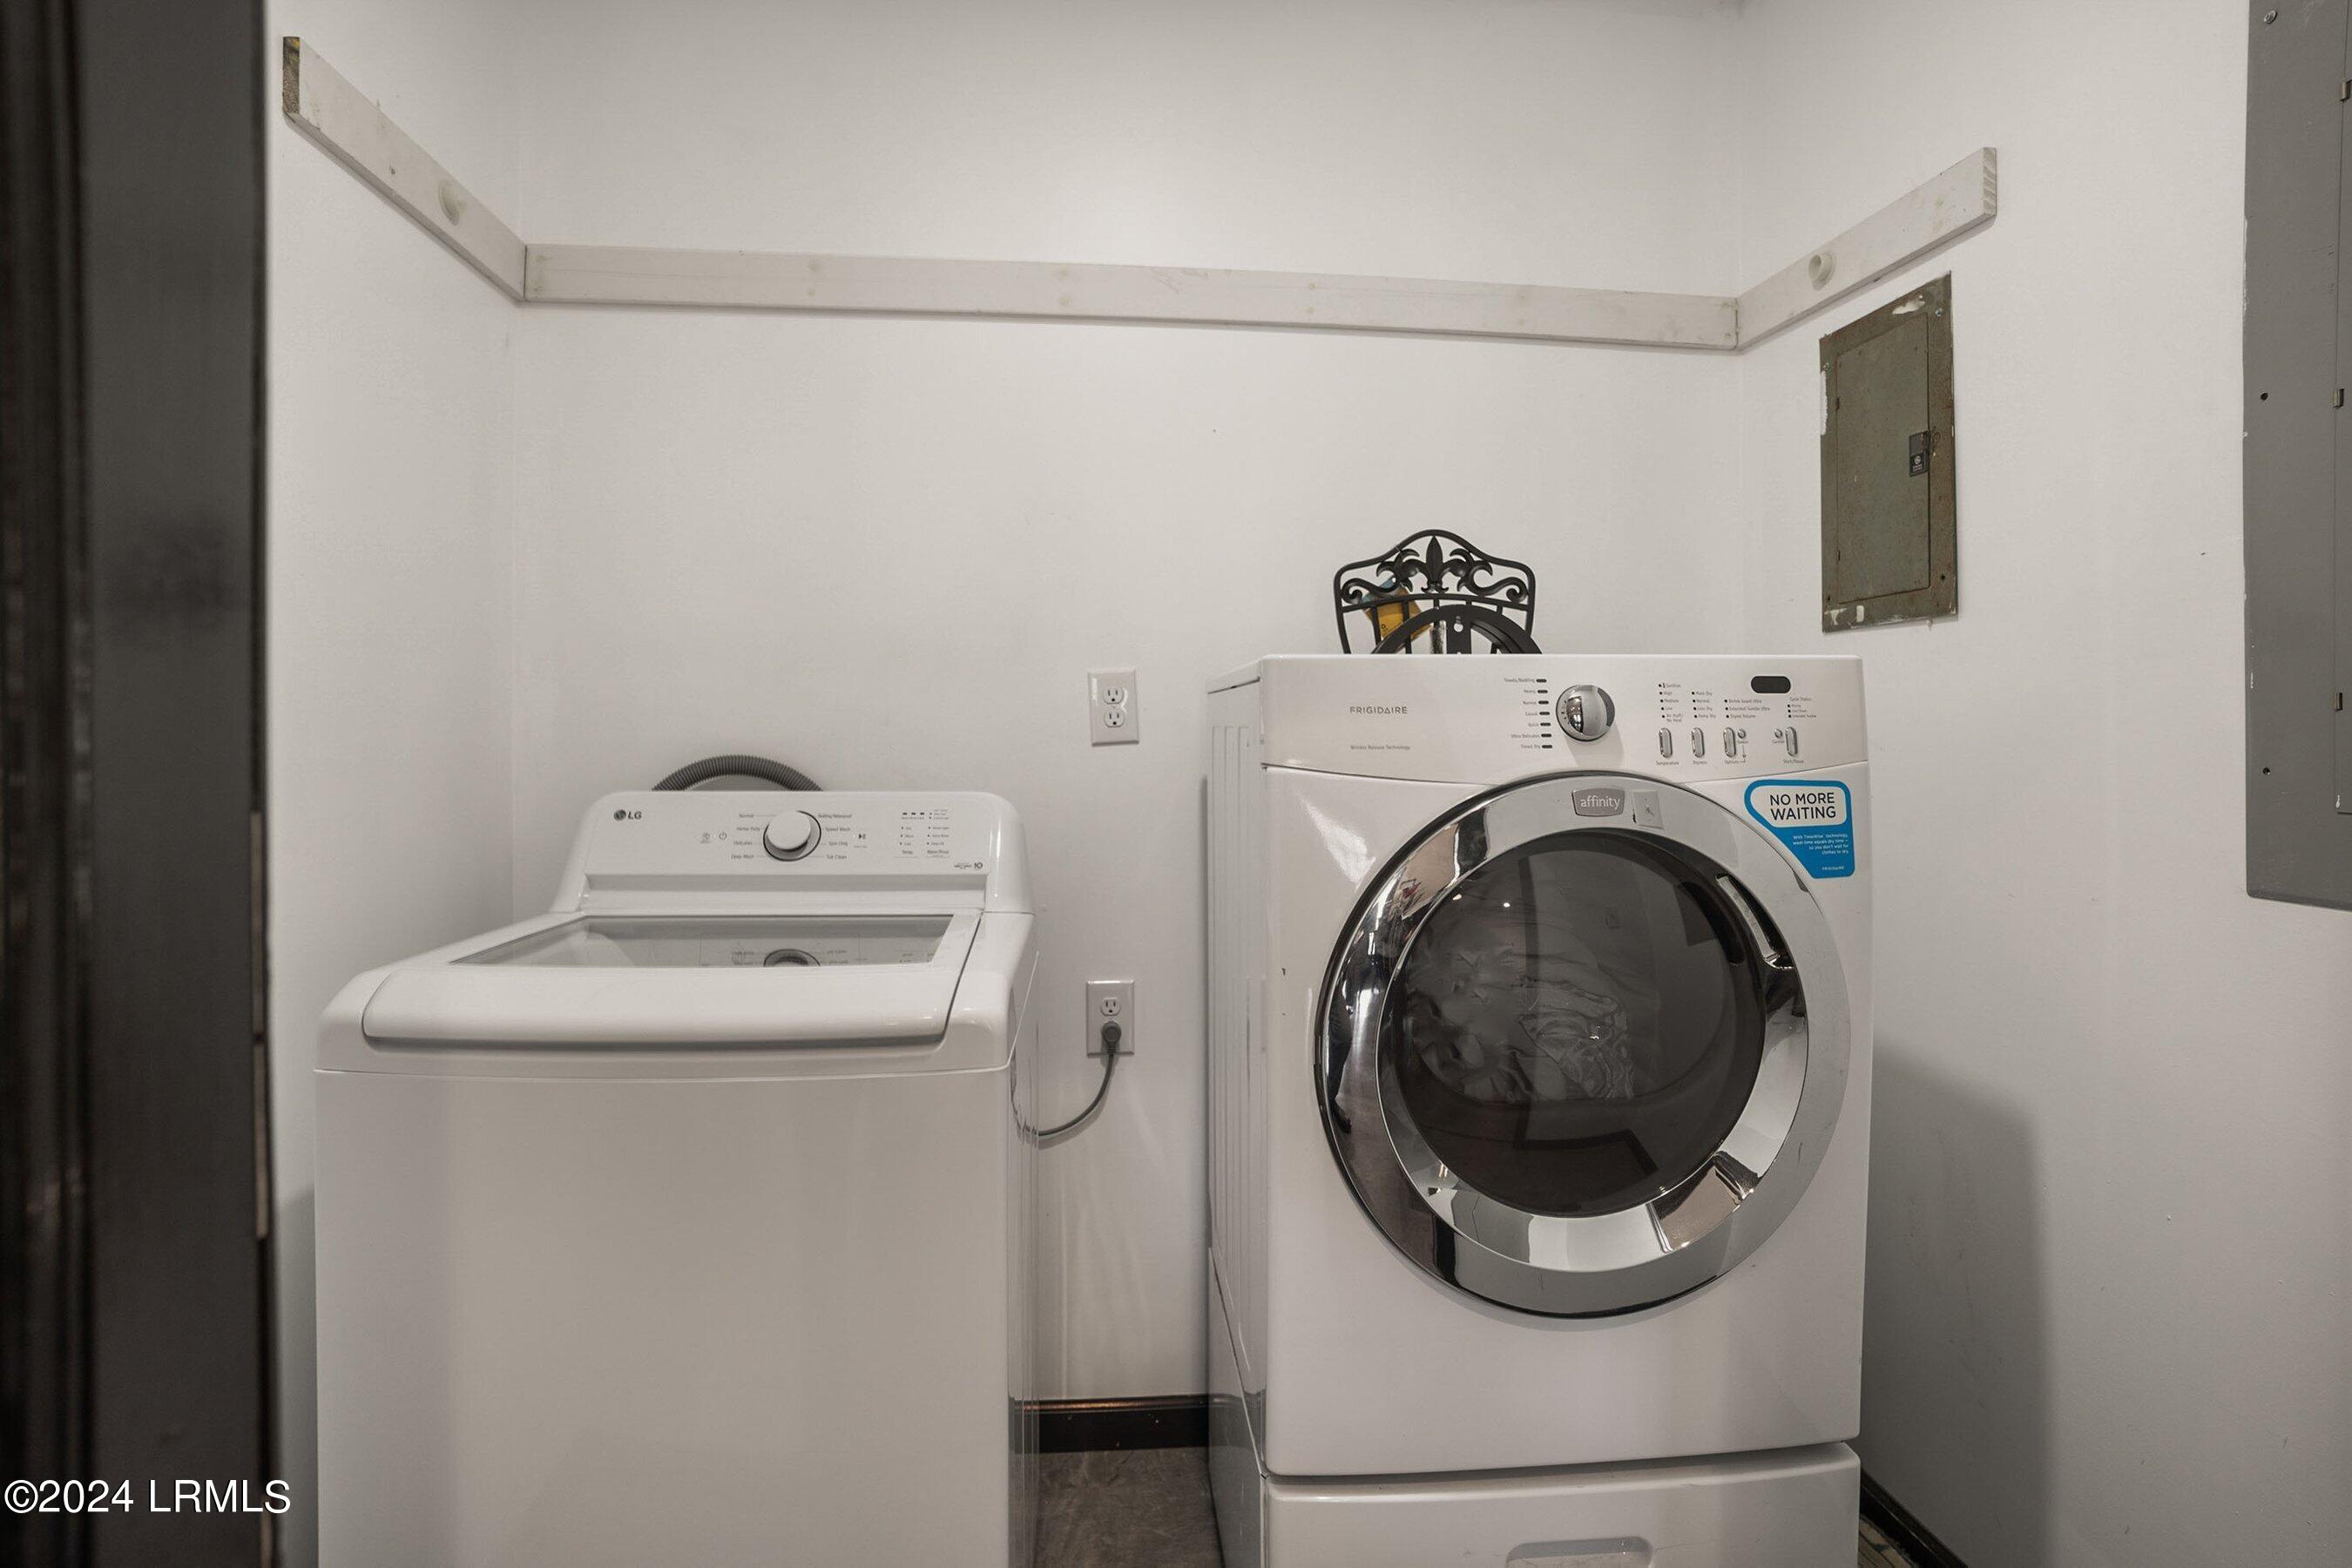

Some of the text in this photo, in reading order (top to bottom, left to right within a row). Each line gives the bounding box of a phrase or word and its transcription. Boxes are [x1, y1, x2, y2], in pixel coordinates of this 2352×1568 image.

[1349, 706, 1409, 714] FRIGIDAIRE
[1580, 794, 1620, 810] affinity
[1770, 792, 1835, 806] NO MORE
[628, 810, 643, 820] LG
[1770, 806, 1836, 821] WAITING
